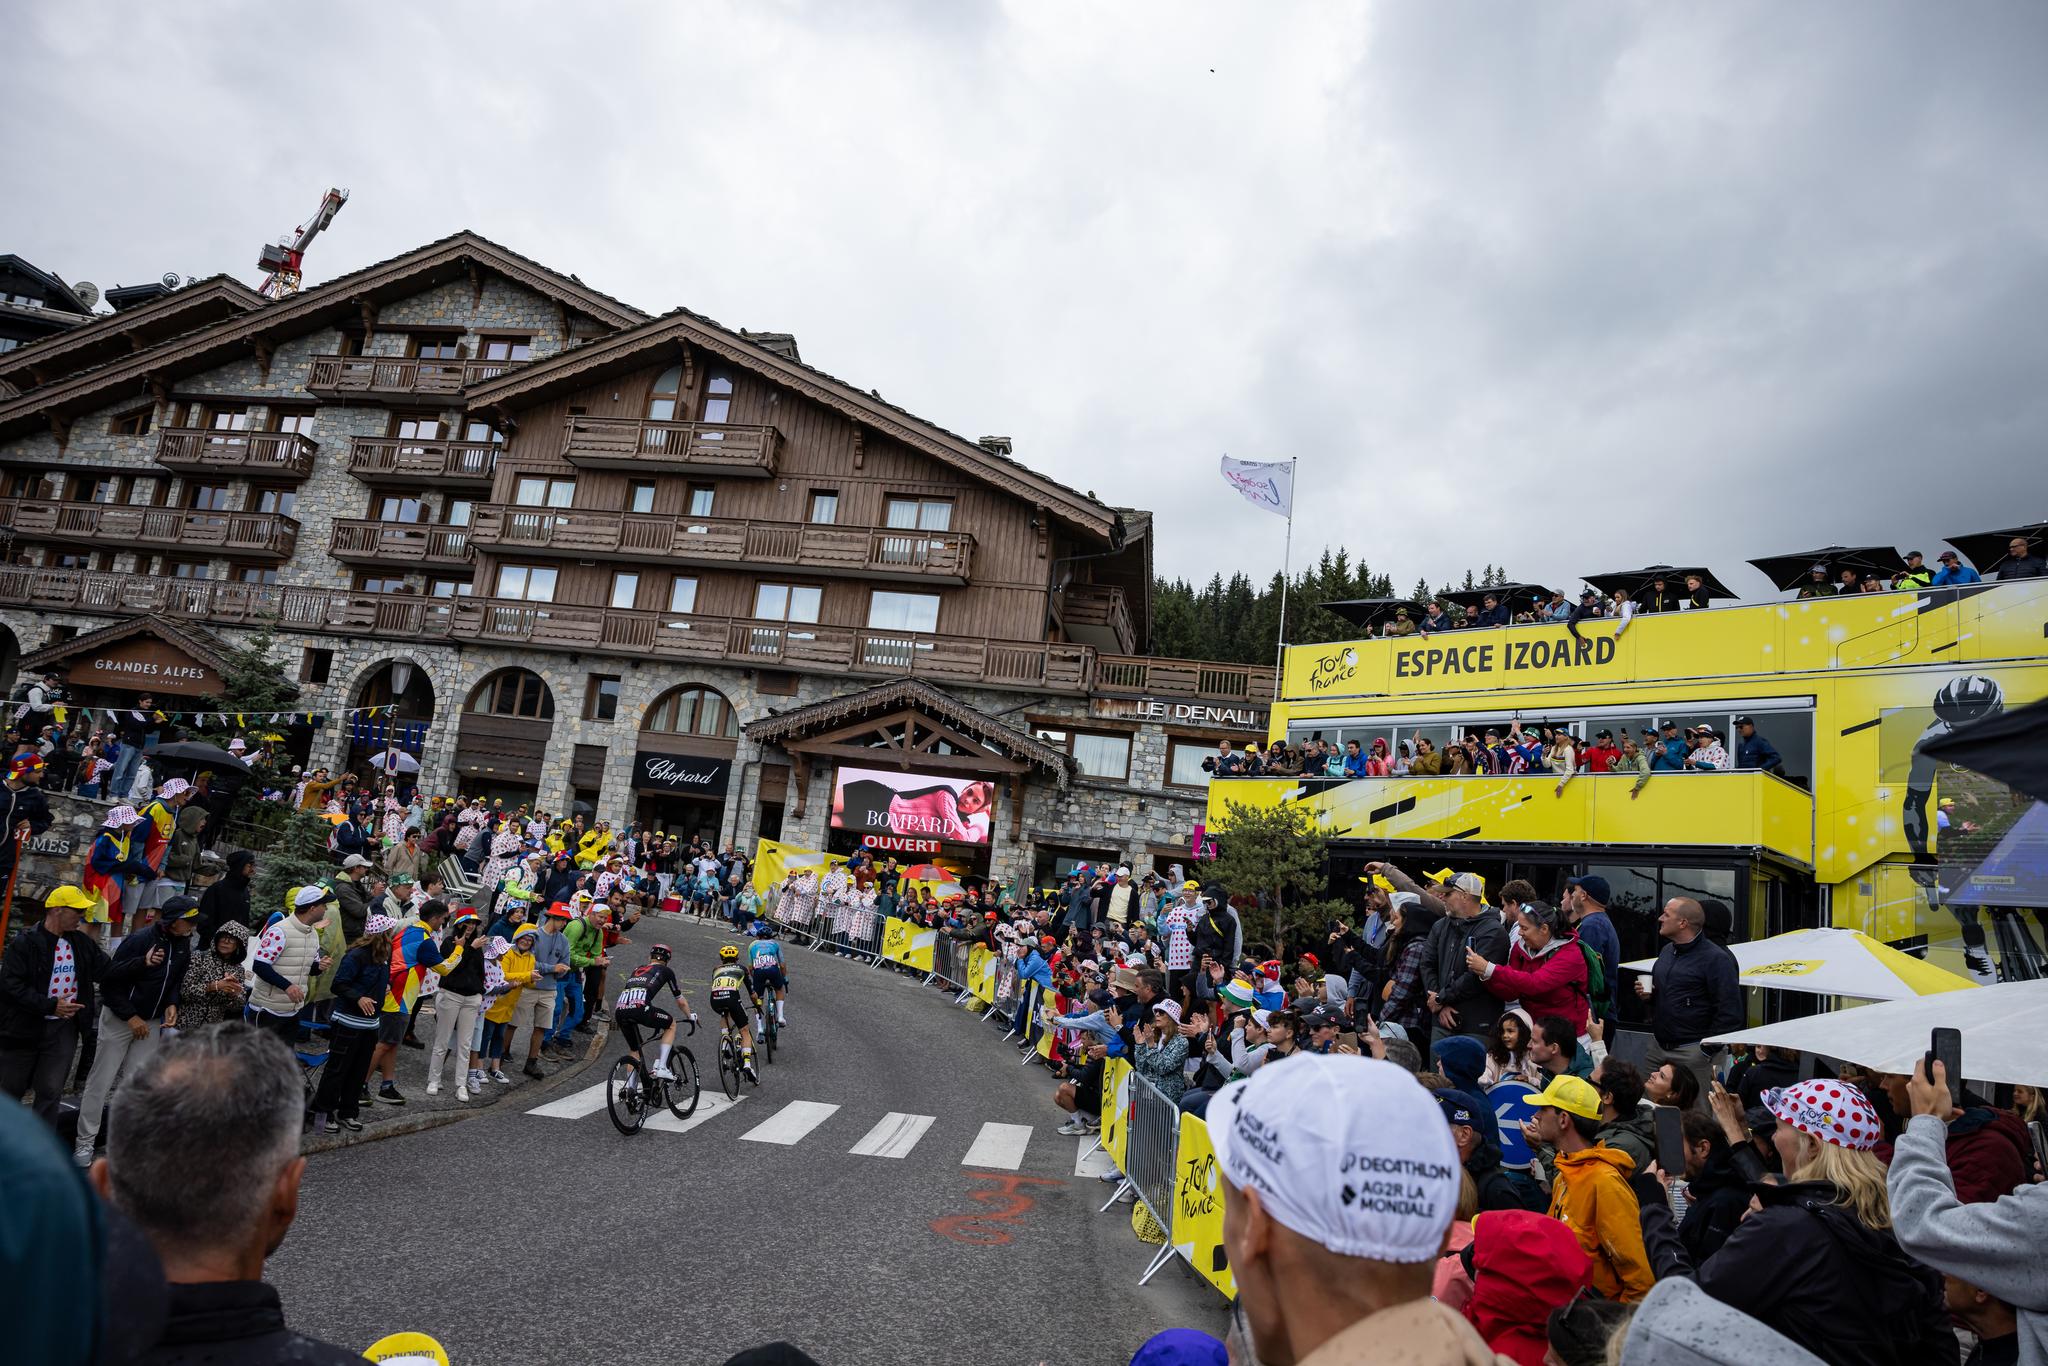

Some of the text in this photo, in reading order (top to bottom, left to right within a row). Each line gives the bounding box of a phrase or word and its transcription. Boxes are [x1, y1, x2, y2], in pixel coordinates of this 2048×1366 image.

[1396, 635, 1616, 678] ESPACE IZOARD
[95, 659, 205, 679] GRANDES ALPES
[1137, 700, 1255, 725] LE DENALI
[645, 757, 720, 786] Chopard
[866, 810, 956, 834] BOMPARD
[864, 835, 939, 852] OUVERT
[714, 978, 735, 988] 18 18
[1359, 1156, 1452, 1180] DECATHLON
[1361, 1181, 1425, 1200] AG2R LA
[1360, 1200, 1435, 1219] MONDIALE
